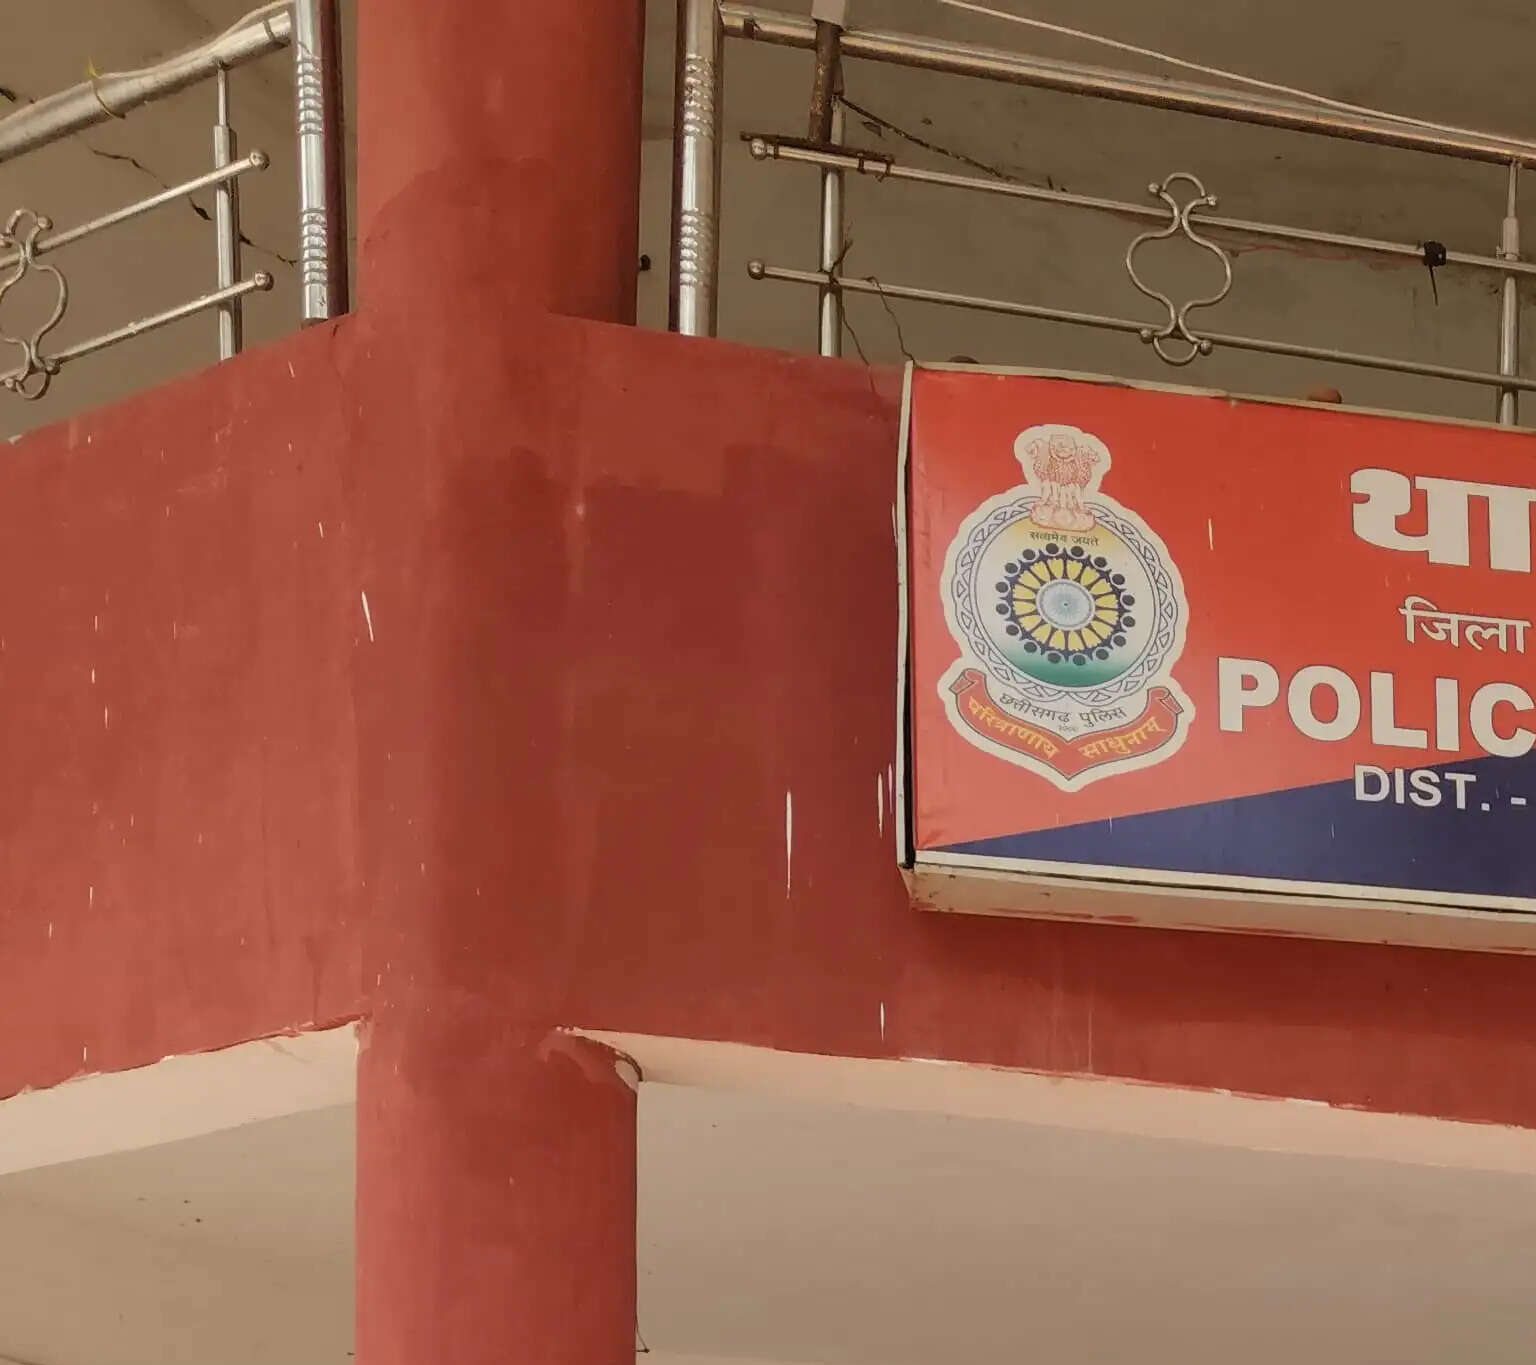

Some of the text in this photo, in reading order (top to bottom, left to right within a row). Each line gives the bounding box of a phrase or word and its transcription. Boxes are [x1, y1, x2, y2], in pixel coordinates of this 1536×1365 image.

[1398, 596, 1531, 655] जिला
[1079, 706, 1128, 728] पुलिस
[1355, 764, 1491, 812] DIST.
